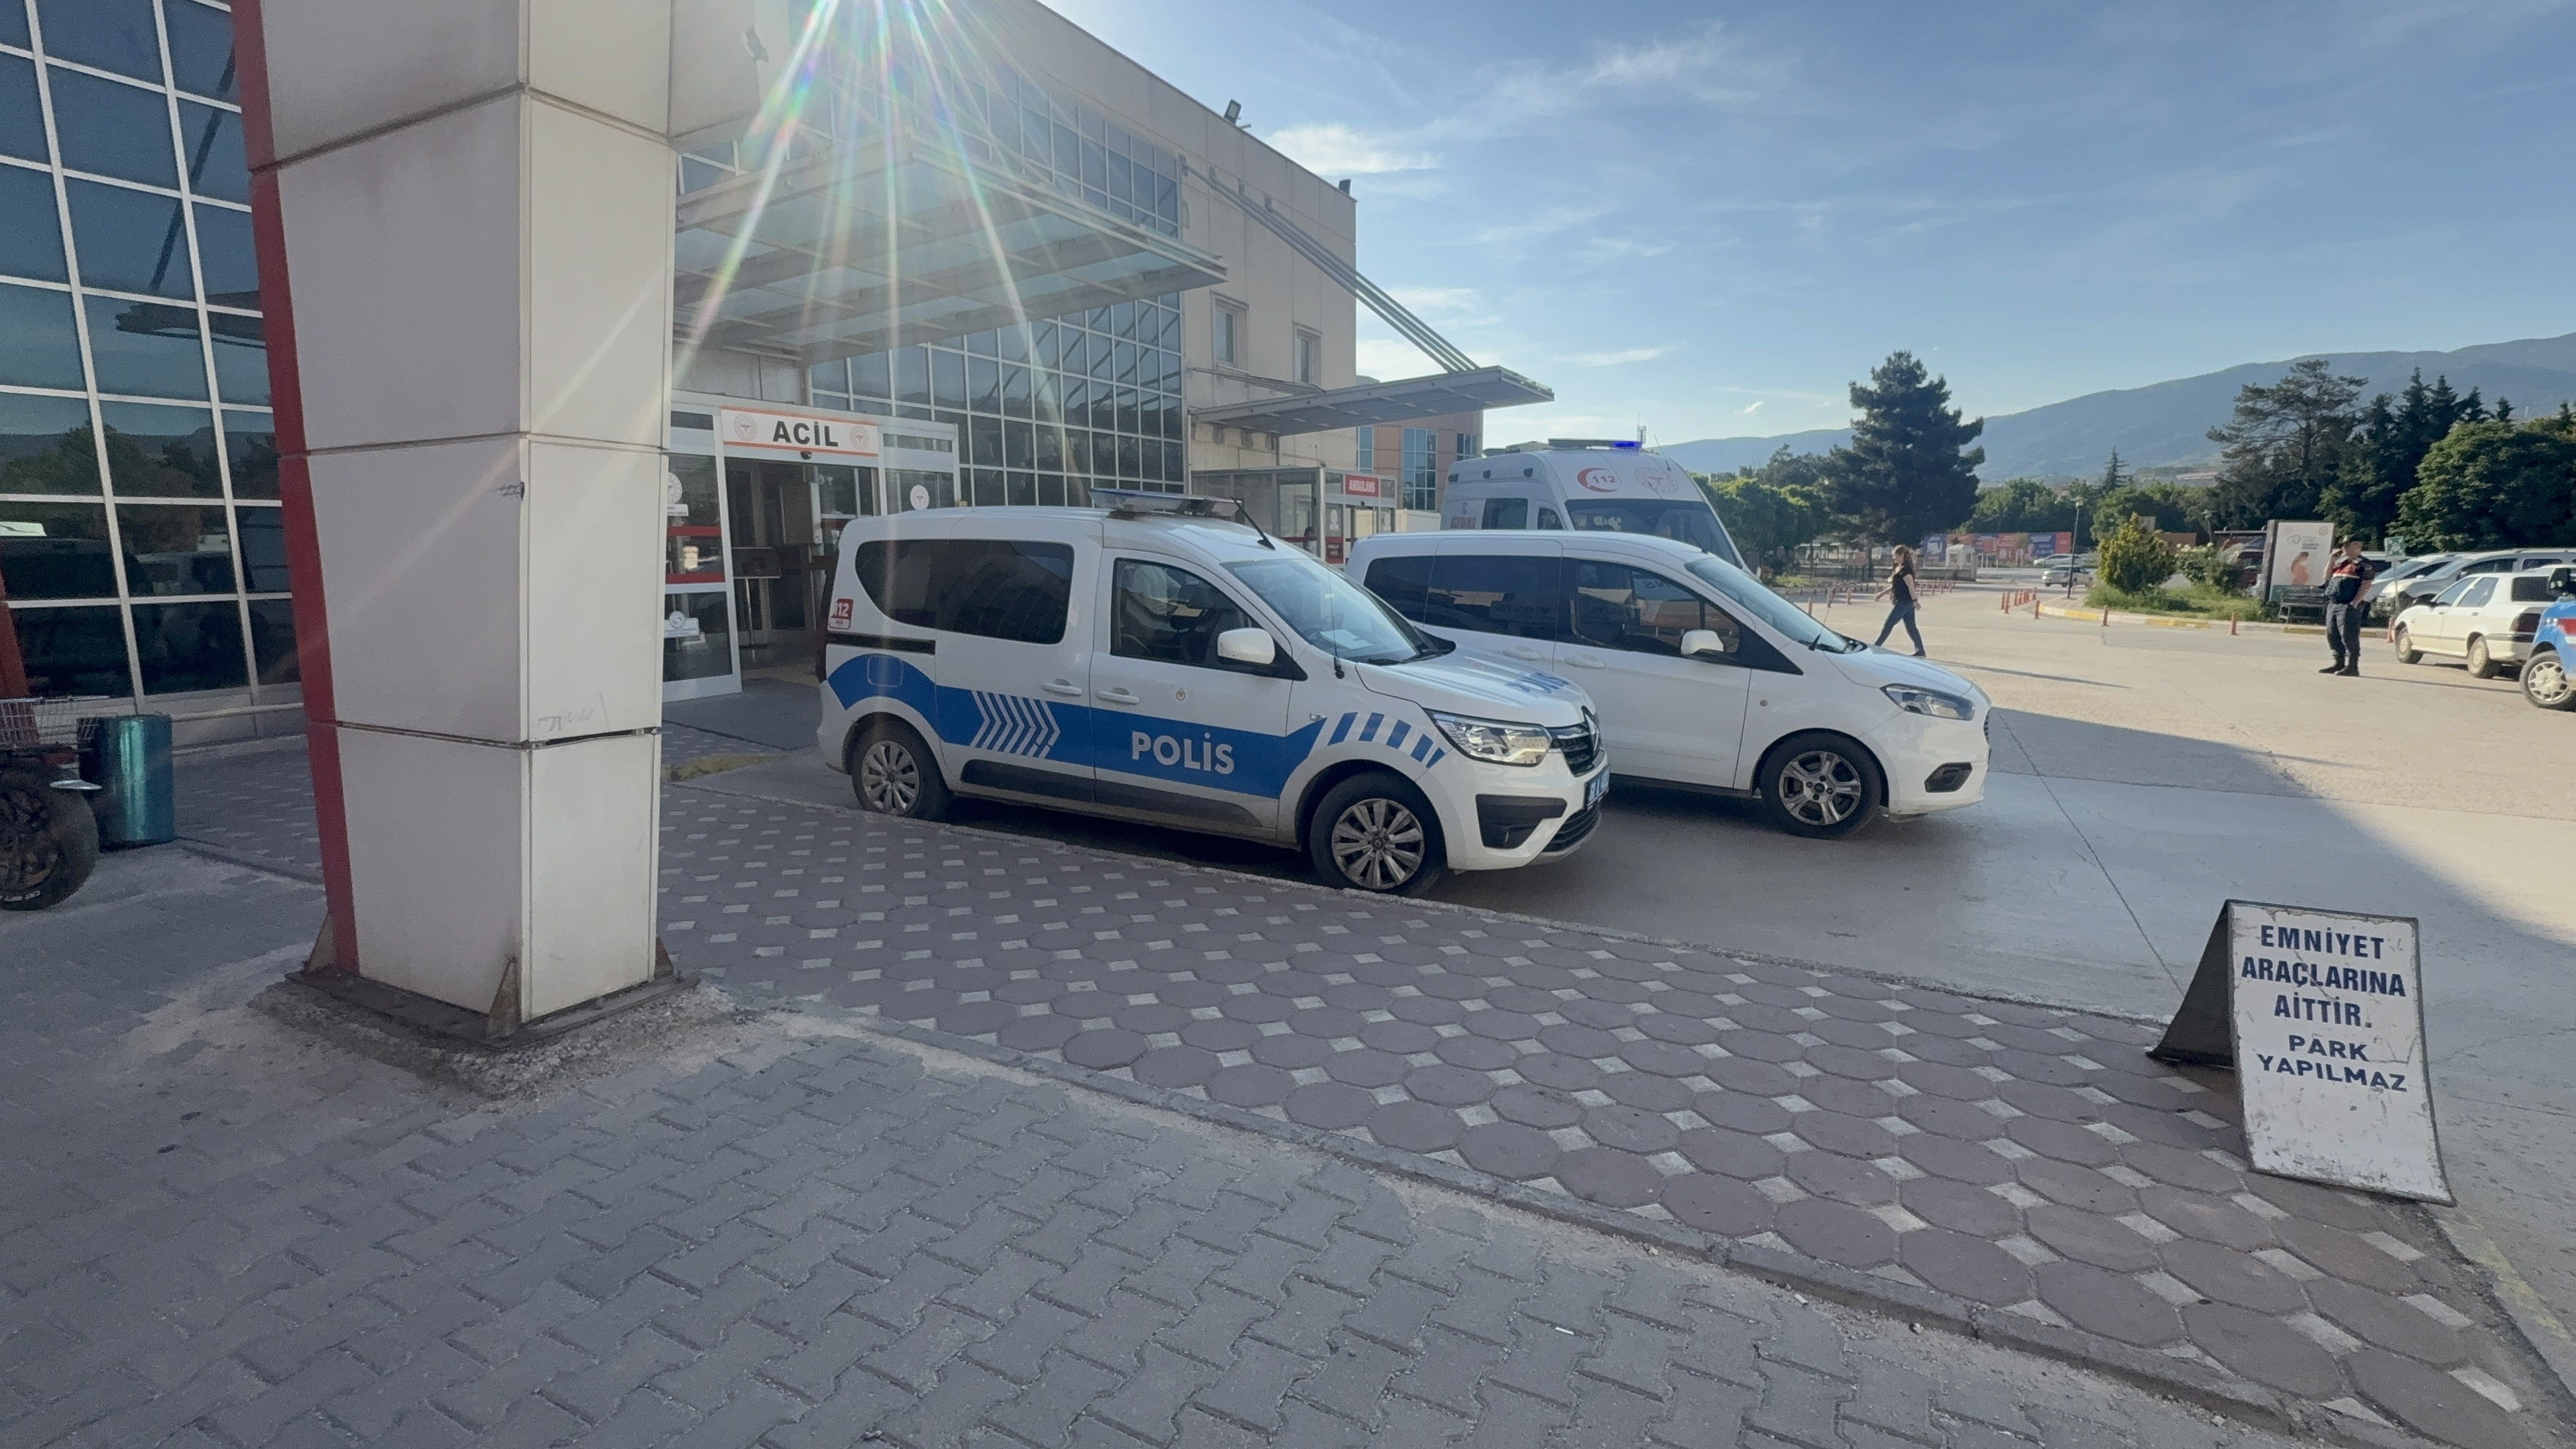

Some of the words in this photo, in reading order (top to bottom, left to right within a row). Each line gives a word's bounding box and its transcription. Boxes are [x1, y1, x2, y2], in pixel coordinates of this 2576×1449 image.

[773, 420, 839, 447] ACİL
[1592, 476, 1617, 484] 112
[1132, 731, 1235, 774] POLİS
[2261, 924, 2384, 959] EMNİYET
[2241, 956, 2406, 997] ARAÇLARINA
[2274, 992, 2372, 1028] AİTTİR.
[2288, 1034, 2370, 1062] PARK
[2256, 1053, 2408, 1093] YAPILMAZ
